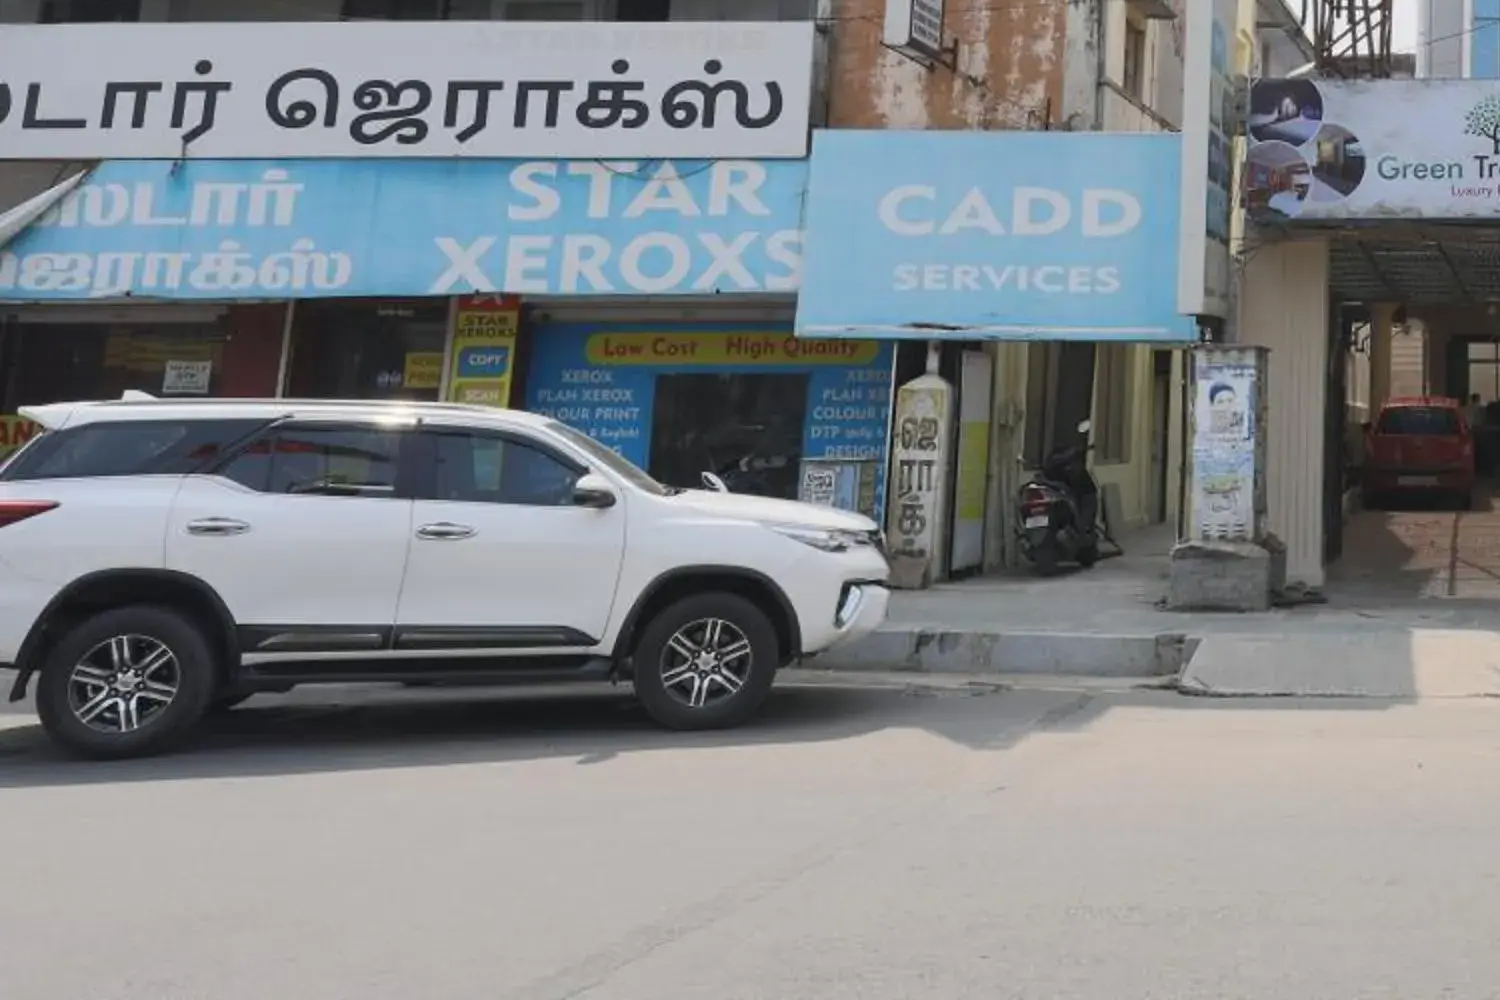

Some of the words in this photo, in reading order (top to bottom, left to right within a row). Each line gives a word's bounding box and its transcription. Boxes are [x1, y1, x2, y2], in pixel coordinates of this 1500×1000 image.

[265, 58, 784, 146] ஜெராக்ஸ்
[1377, 155, 1464, 180] Green
[507, 160, 772, 222] STAR
[1450, 184, 1493, 198] Luxury
[877, 184, 1143, 238] CADD
[427, 229, 805, 296] XEROXS
[892, 263, 1122, 294] SERVICES
[468, 353, 505, 366] COPY
[604, 337, 643, 356] Low
[651, 338, 698, 356] Cost
[725, 337, 776, 360] High
[783, 337, 860, 358] Quality
[562, 369, 614, 383] XEROX
[537, 389, 578, 402] PLAN
[581, 388, 635, 402] XEROX
[594, 406, 640, 421] PRINT
[813, 407, 876, 420] COLOUR
